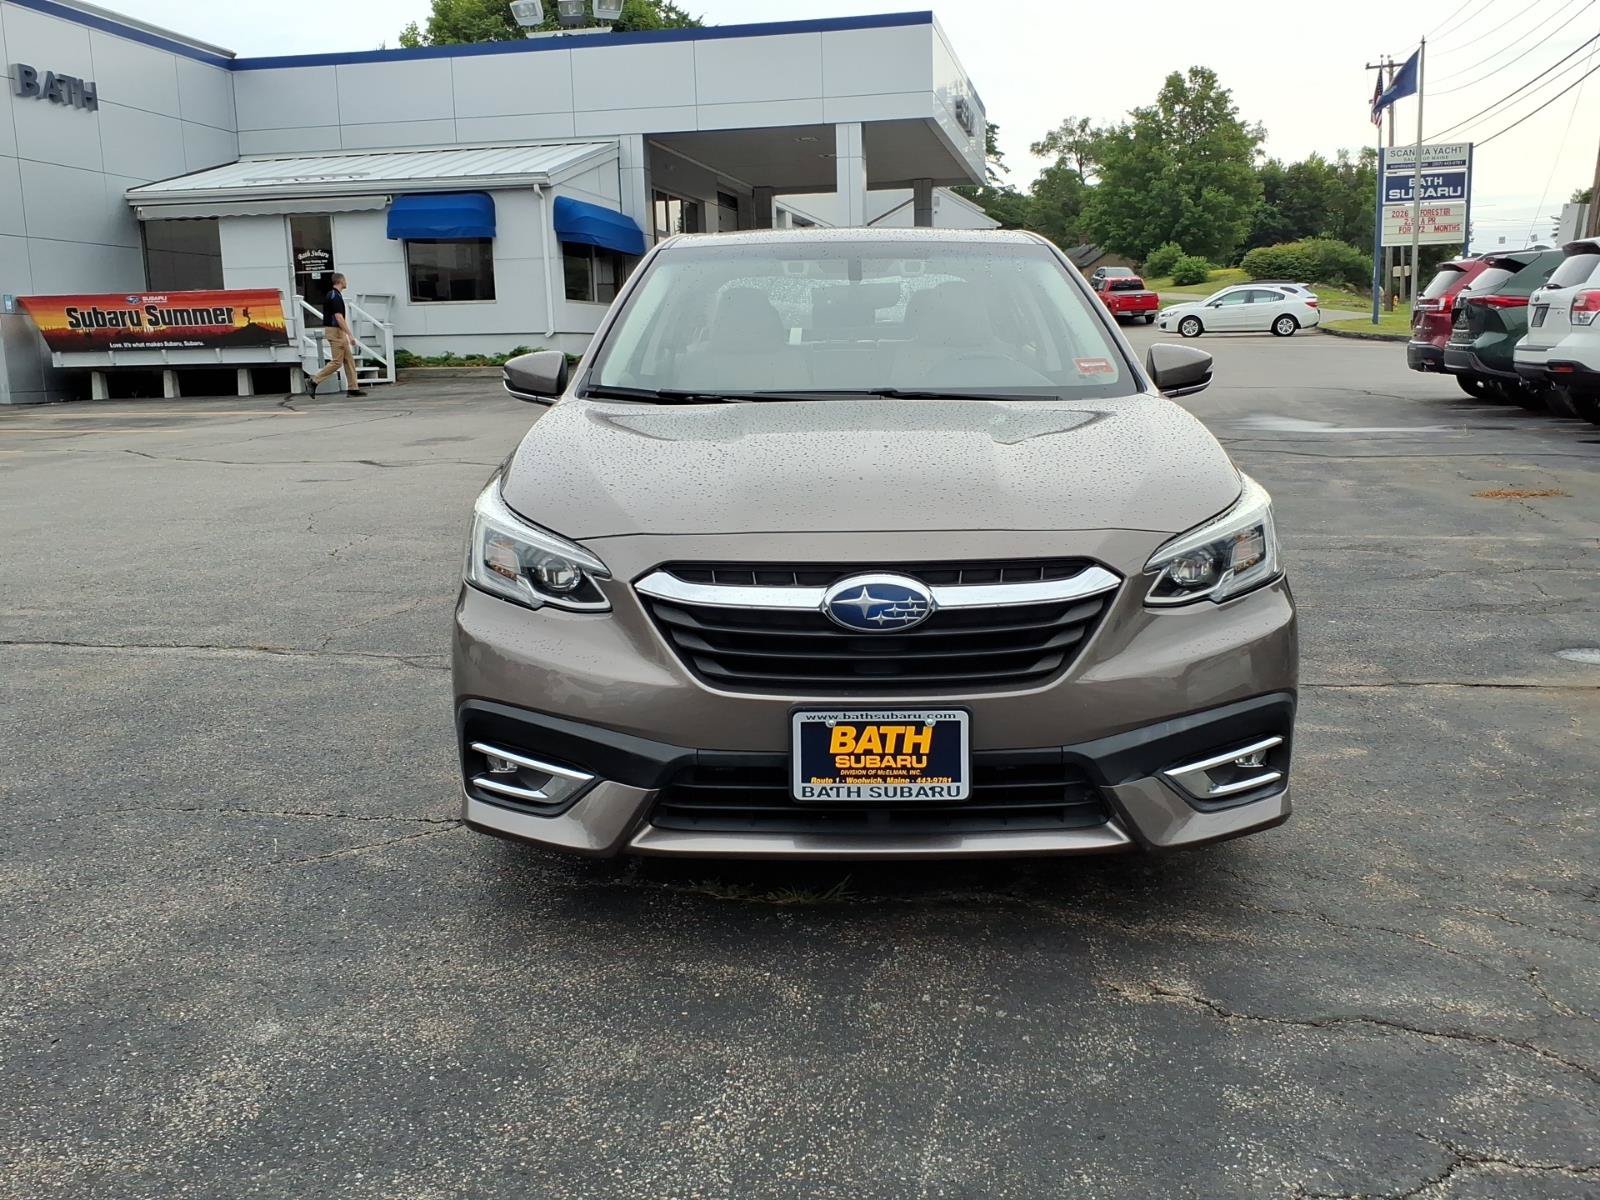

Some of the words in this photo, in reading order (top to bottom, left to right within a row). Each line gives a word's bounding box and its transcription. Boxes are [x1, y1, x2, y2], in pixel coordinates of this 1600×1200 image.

[10, 63, 98, 112] BATH
[1390, 149, 1430, 157] SCANIA
[1433, 146, 1463, 155] YACHT
[1409, 177, 1442, 187] BATH
[1391, 209, 1409, 218] 2026
[1420, 208, 1451, 216] FORESTER
[1398, 226, 1411, 234] FOR
[1434, 224, 1460, 232] MONTHS
[65, 306, 143, 329] Subaru
[144, 304, 234, 328] Summer
[805, 712, 956, 720] www.bathsubaru.com
[829, 725, 933, 754] BATH
[835, 755, 927, 768] SUBARU
[887, 776, 910, 784] Maine
[801, 785, 862, 798] BATH
[869, 785, 961, 798] SUBARU
